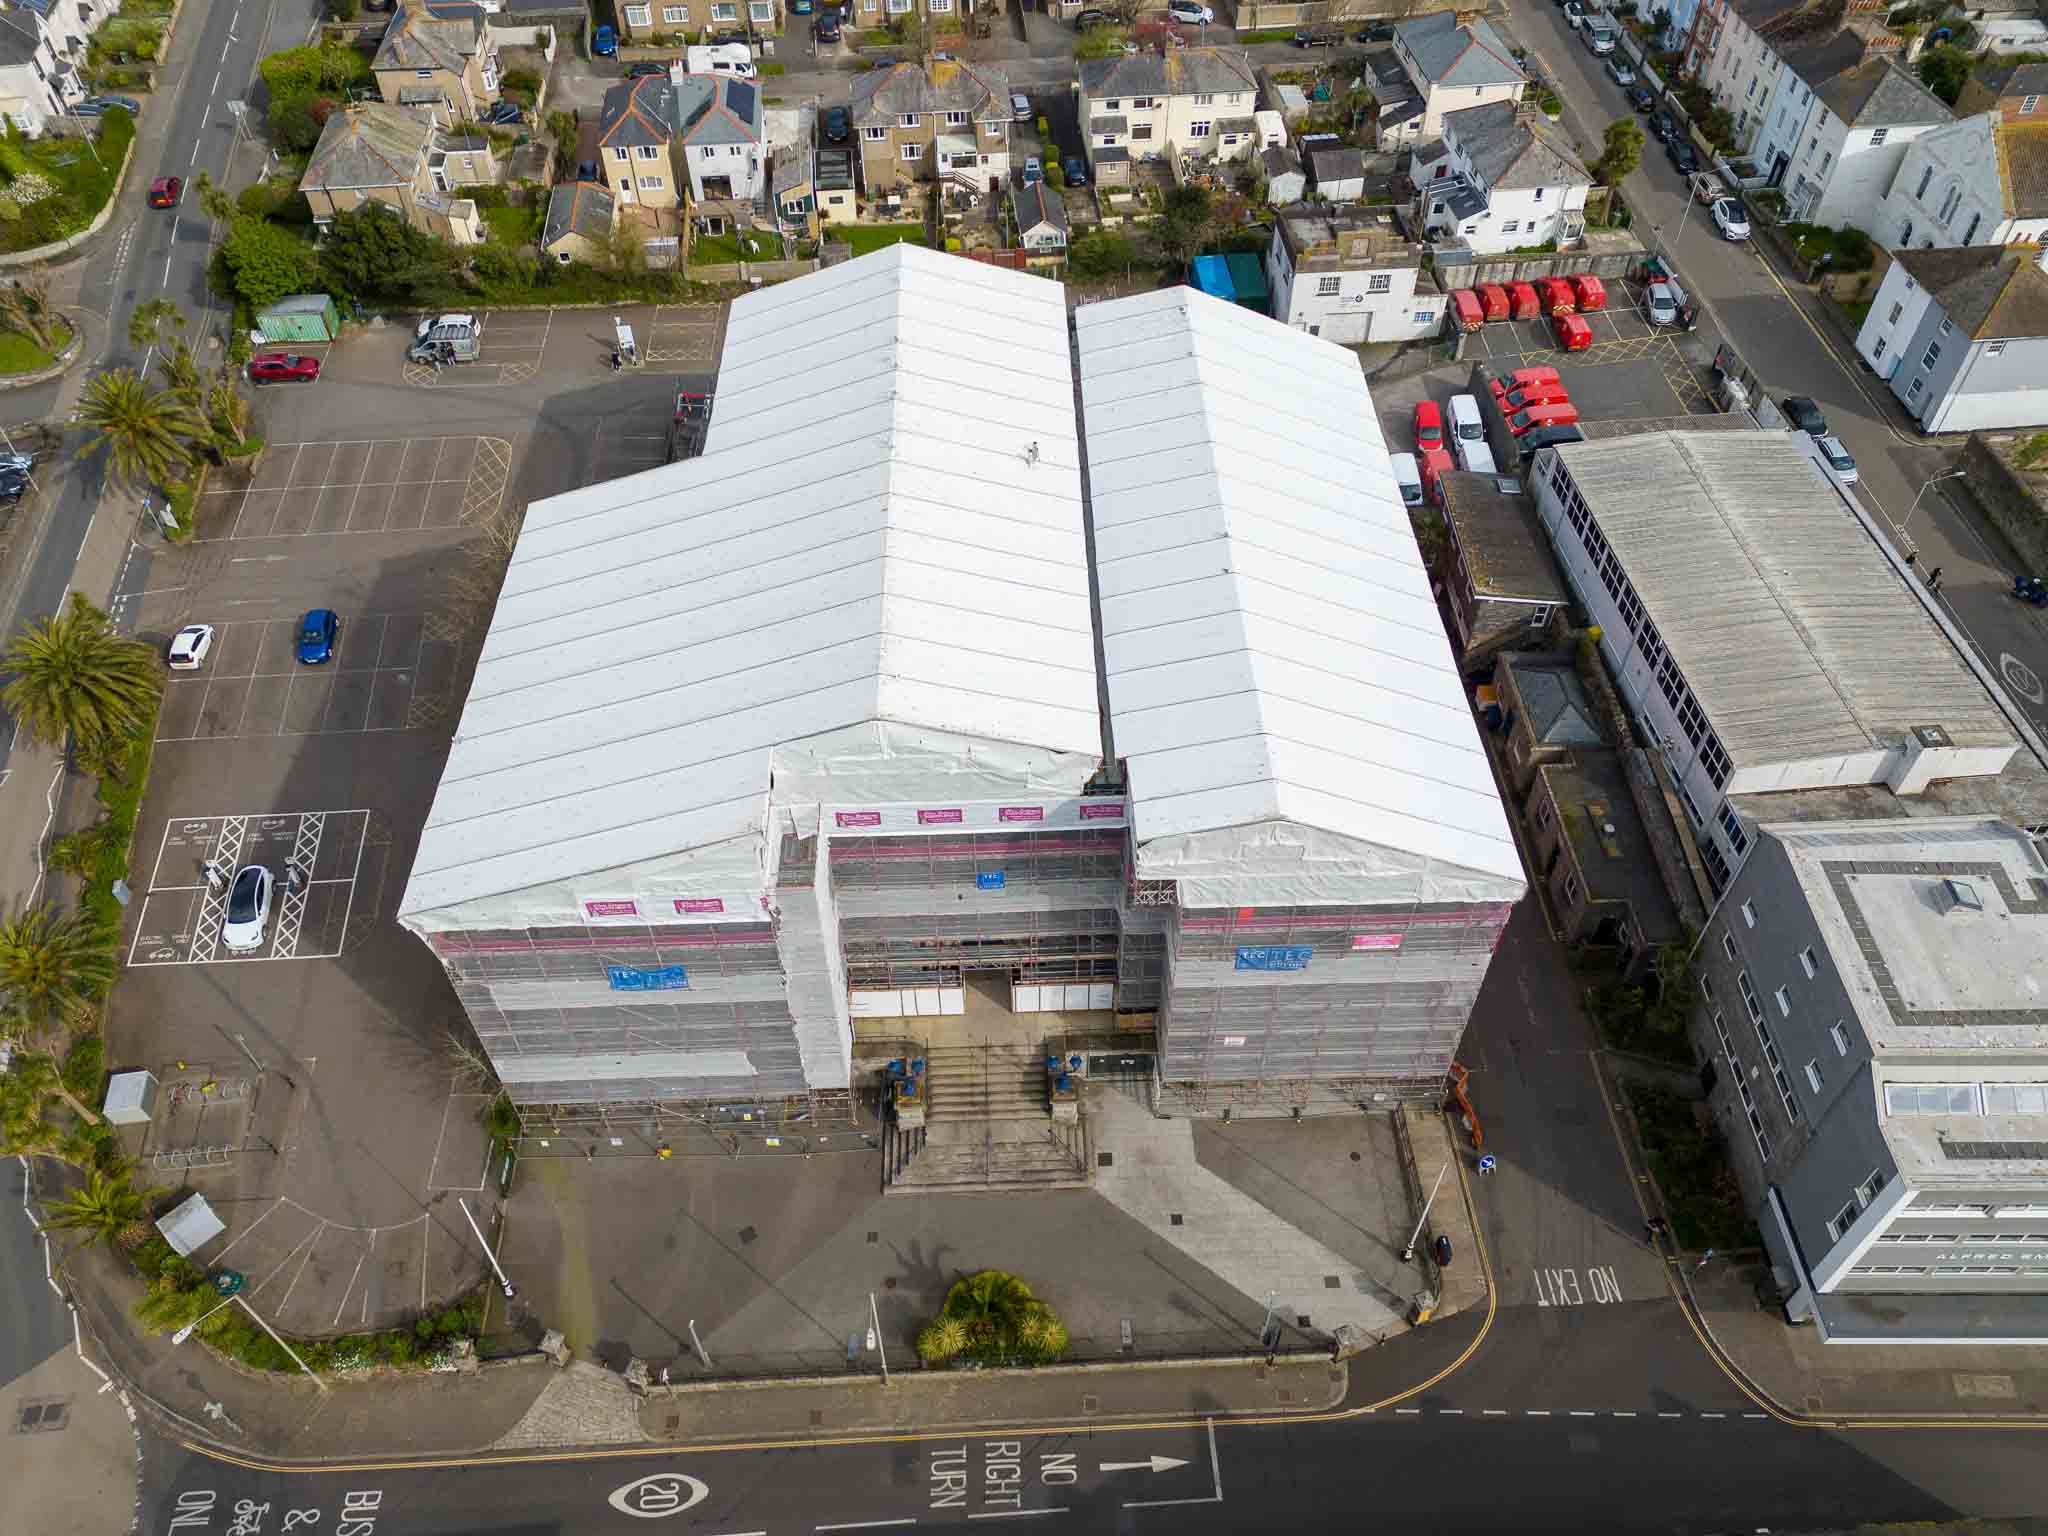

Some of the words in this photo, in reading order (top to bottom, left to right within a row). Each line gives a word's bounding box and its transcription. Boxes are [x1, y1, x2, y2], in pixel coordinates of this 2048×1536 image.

[1533, 1268, 1584, 1306] EXIT
[1588, 1265, 1624, 1304] NO
[929, 1445, 968, 1509] TURN
[984, 1440, 1022, 1508] RIGHT
[1039, 1453, 1078, 1486] NO
[168, 1490, 217, 1536] ONL
[336, 1490, 383, 1536] BUS
[640, 1482, 679, 1509] 20
